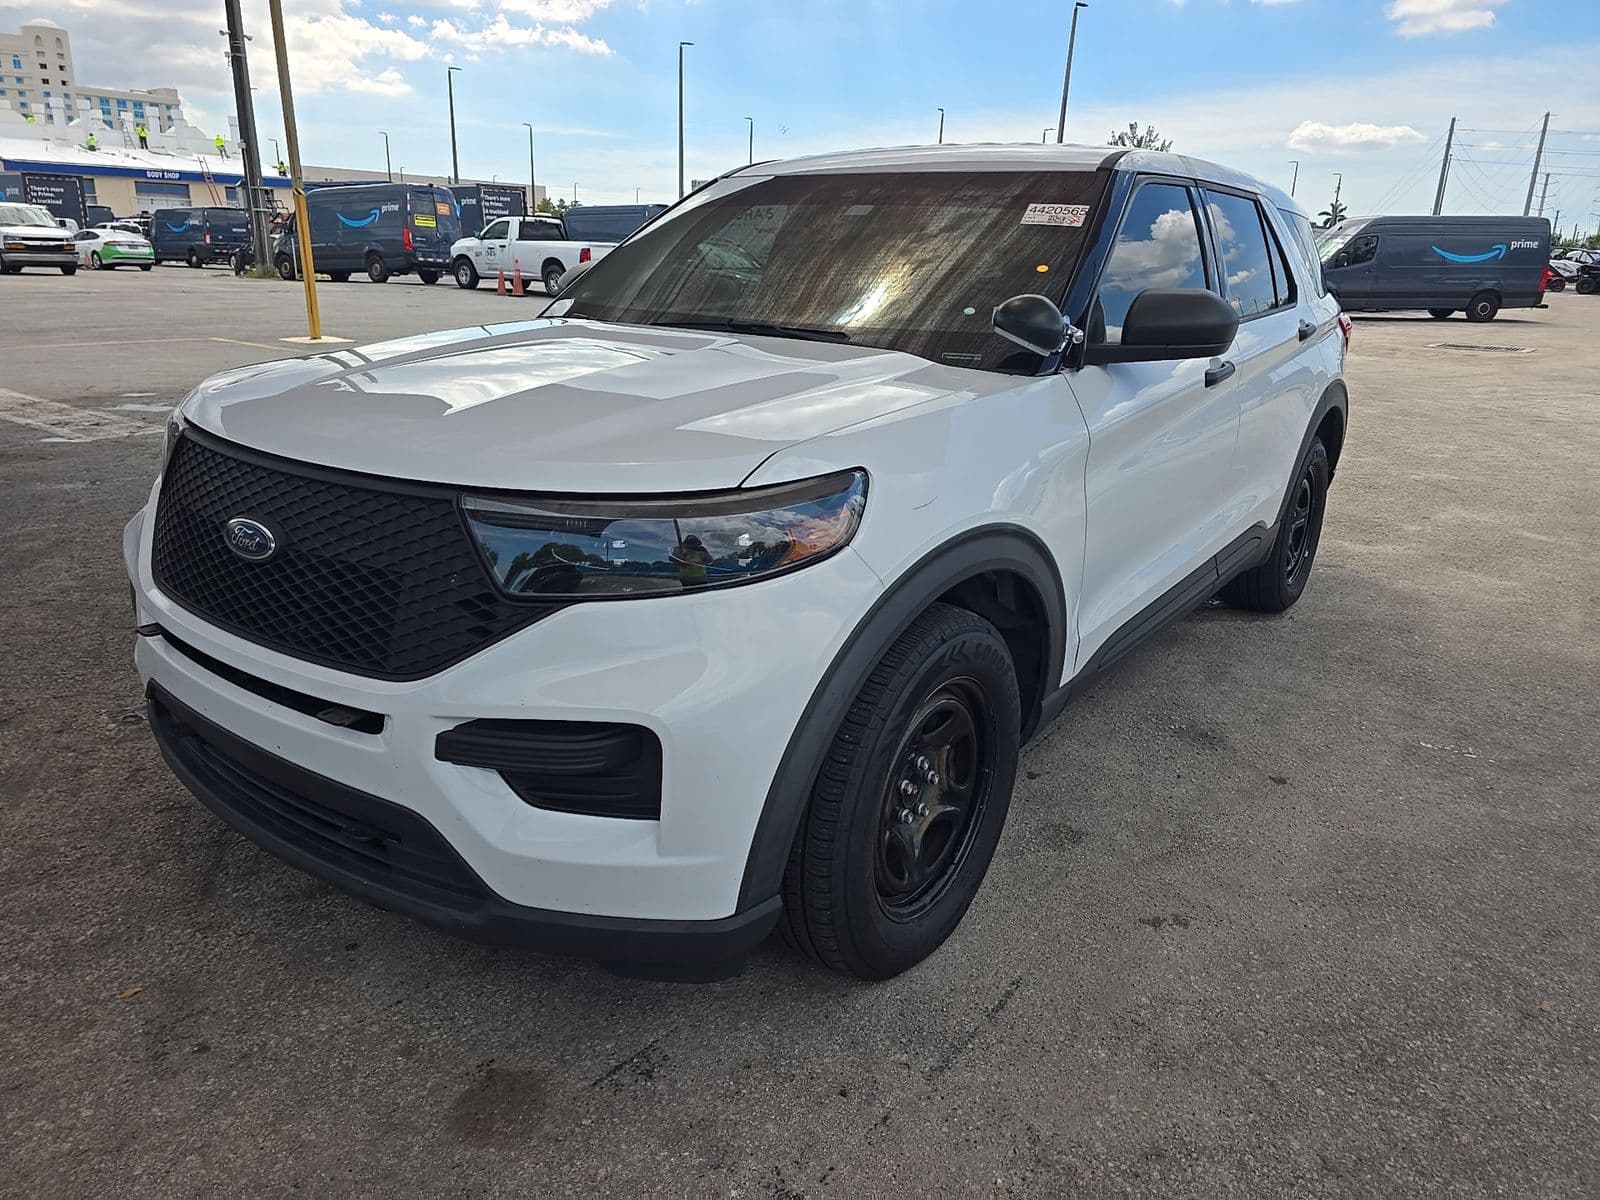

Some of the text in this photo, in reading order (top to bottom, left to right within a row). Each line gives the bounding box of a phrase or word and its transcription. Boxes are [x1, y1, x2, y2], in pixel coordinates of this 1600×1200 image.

[461, 196, 476, 207] prime
[381, 202, 399, 214] prime
[1030, 206, 1088, 215] 4420565
[1511, 239, 1538, 250] prime
[232, 526, 259, 550] Ford
